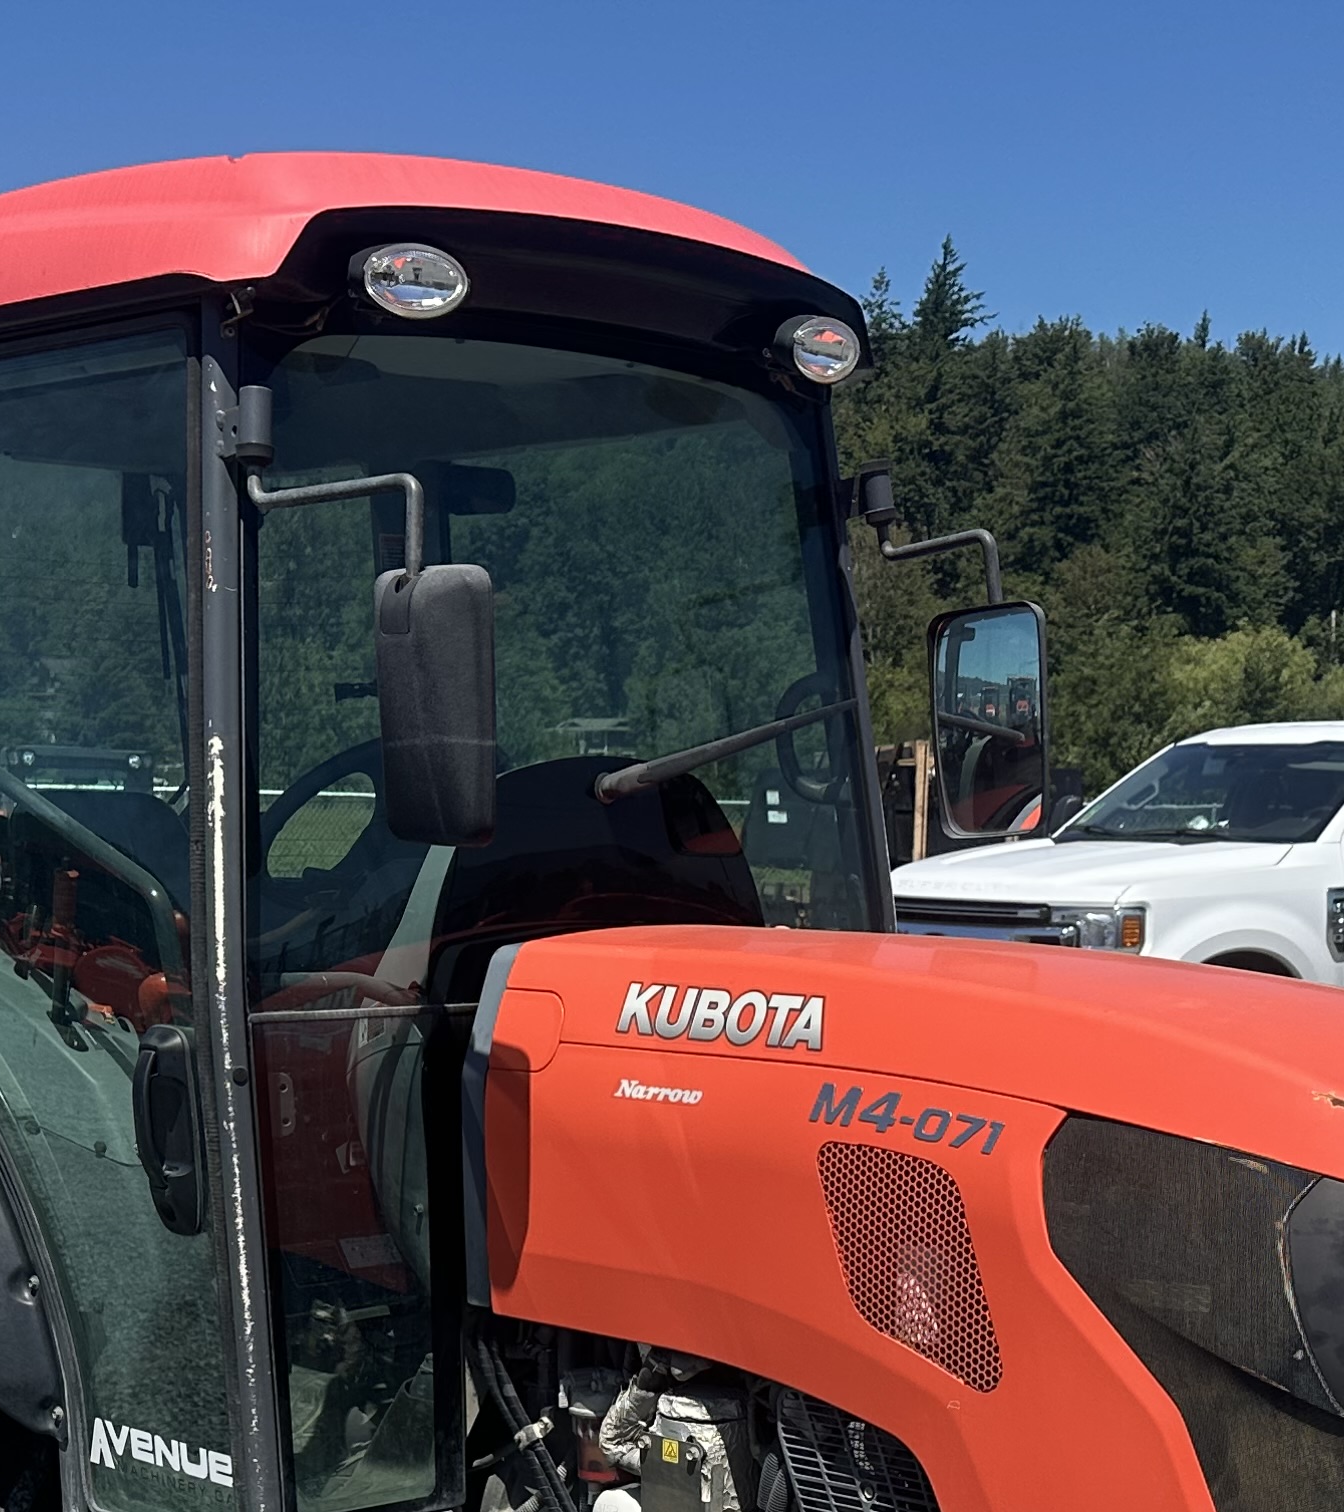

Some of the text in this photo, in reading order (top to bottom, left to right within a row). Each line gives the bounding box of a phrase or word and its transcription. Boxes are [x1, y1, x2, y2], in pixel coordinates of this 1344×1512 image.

[616, 981, 827, 1051] KUBOTA
[614, 1079, 704, 1104] Narrow
[809, 1082, 1005, 1155] M4-071
[89, 1417, 234, 1488] AVENUE
